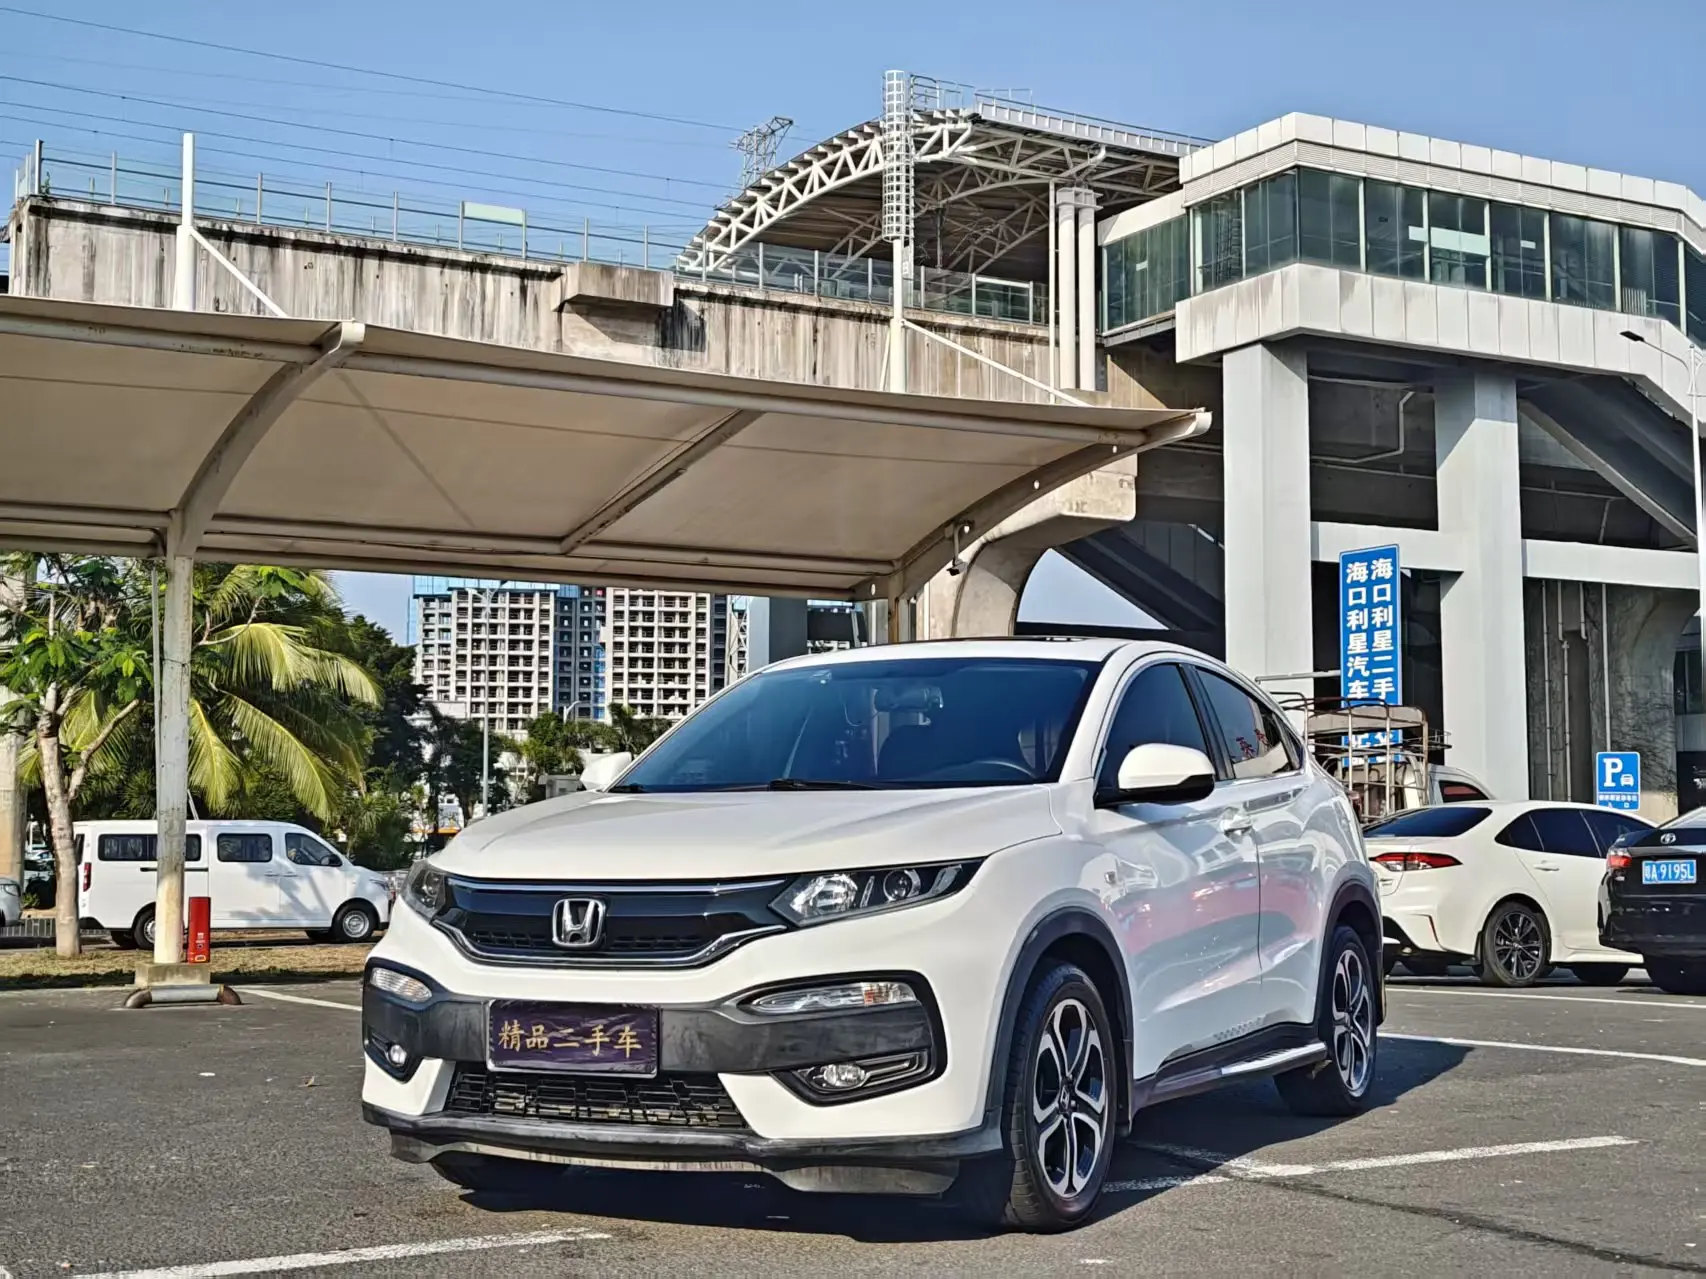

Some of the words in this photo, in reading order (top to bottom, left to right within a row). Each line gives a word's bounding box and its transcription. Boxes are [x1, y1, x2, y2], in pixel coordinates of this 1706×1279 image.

[1603, 758, 1623, 787] P
[499, 1020, 642, 1058] 精品二手车
